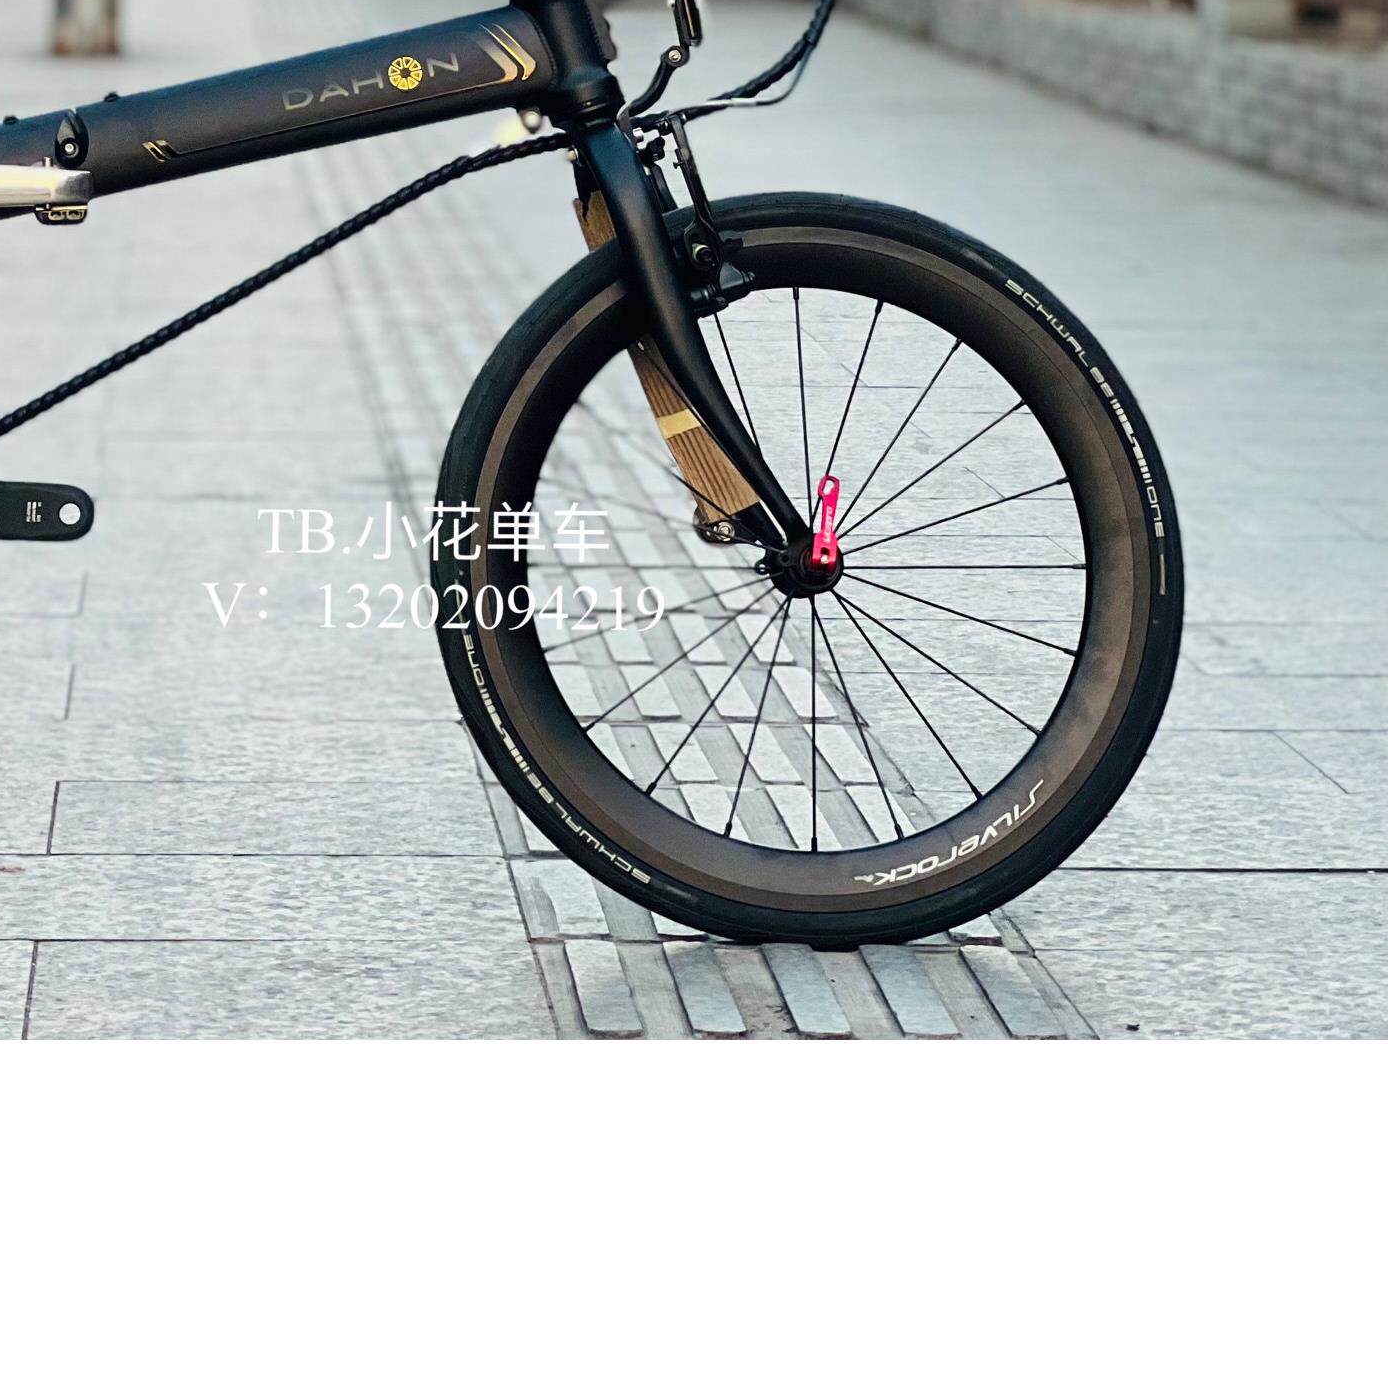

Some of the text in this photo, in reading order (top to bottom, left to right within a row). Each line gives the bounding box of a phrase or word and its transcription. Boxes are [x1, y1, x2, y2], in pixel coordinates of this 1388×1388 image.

[281, 52, 460, 111] DAHON
[1004, 278, 1114, 399] SCHWALBE
[526, 773, 652, 885] SCHWALBE
